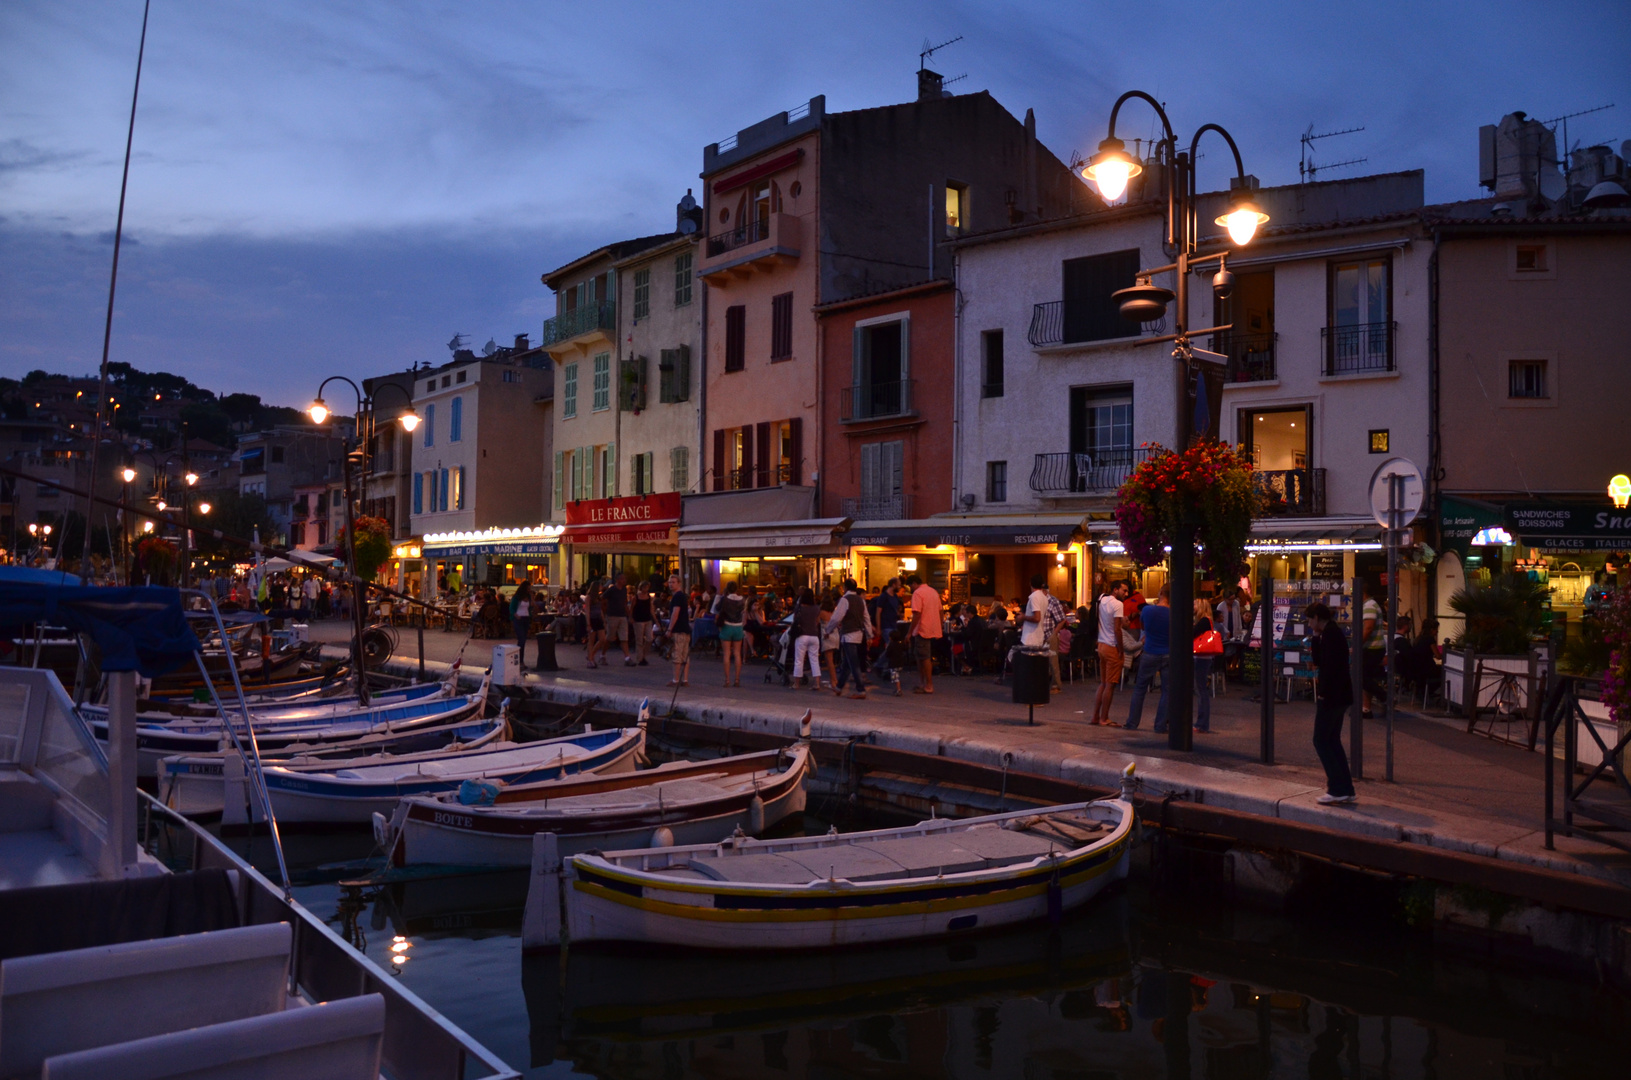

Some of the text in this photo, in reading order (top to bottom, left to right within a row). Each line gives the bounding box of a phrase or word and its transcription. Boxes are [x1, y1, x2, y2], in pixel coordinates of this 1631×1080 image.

[591, 505, 651, 522] LE FRANCE
[1512, 510, 1571, 519] SANDWICHES
[1518, 519, 1565, 528] BOISSONS
[562, 531, 666, 543] BAR BRASSERIE GLACIER
[765, 538, 776, 546] BAR
[799, 536, 815, 544] PORT
[851, 536, 889, 544] RESTAURANT
[1014, 534, 1059, 544] RESTAURANT
[1545, 539, 1585, 547] GLACES
[449, 548, 463, 556] BAR
[466, 546, 476, 554] DE
[480, 546, 490, 554] LA
[494, 545, 523, 554] MARINE
[280, 779, 309, 790] Cassis
[434, 812, 473, 828] BOITE
